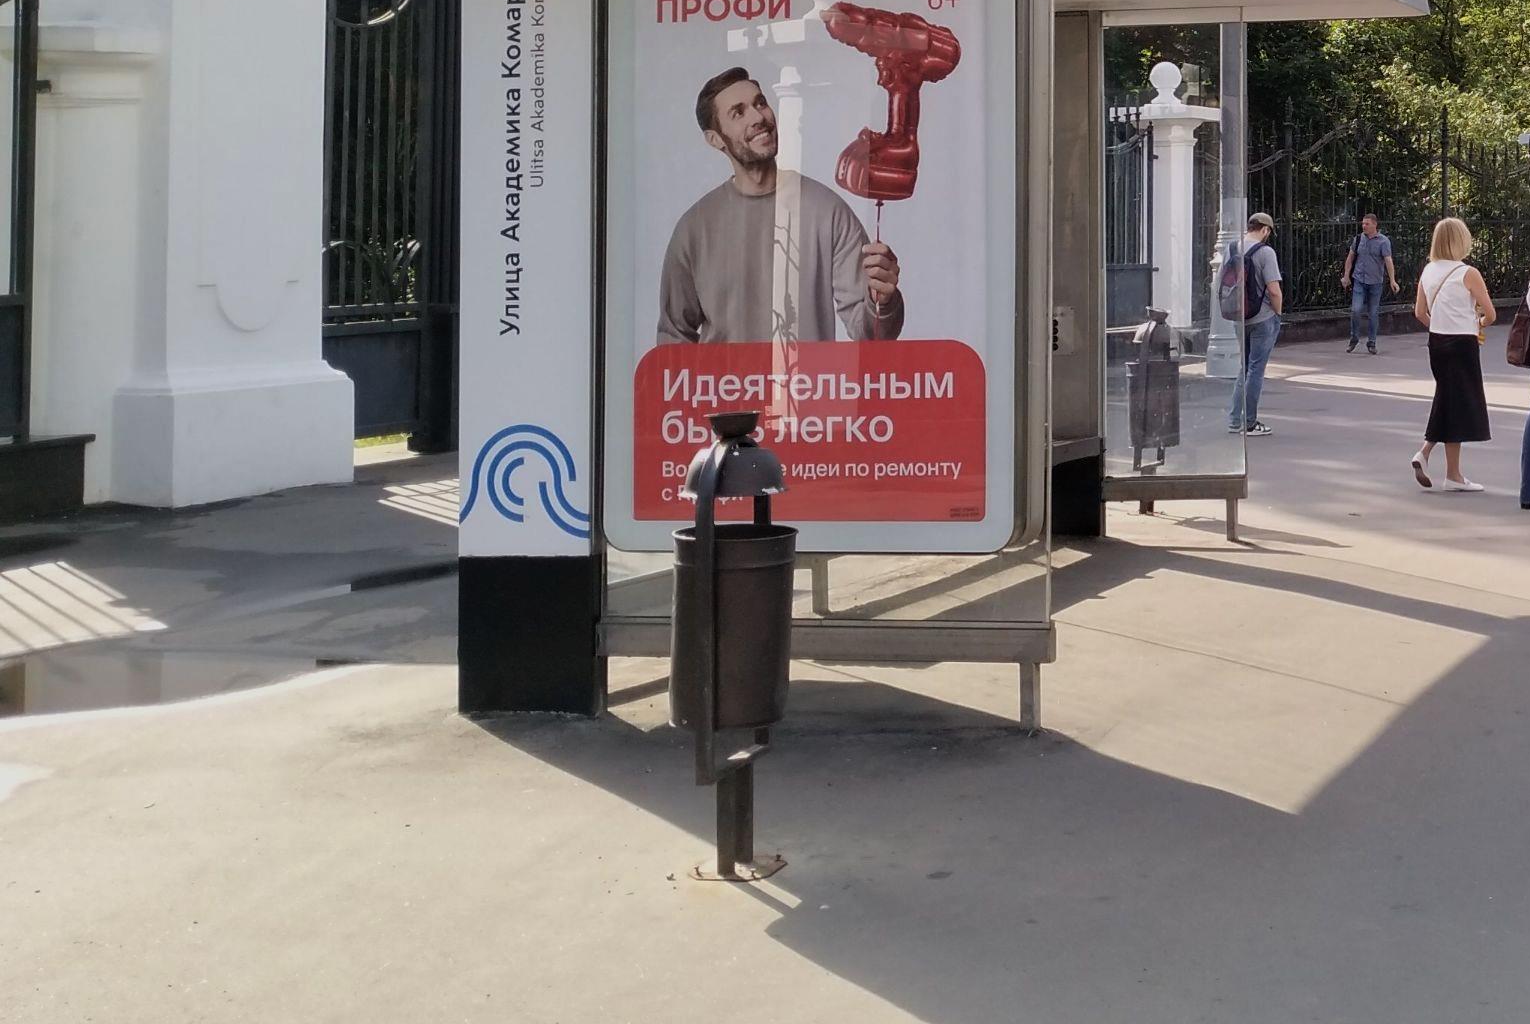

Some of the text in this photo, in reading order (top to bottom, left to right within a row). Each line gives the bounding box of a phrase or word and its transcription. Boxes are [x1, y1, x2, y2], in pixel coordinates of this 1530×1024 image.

[530, 33, 545, 132] Akademika
[500, 88, 524, 241] Академика
[530, 139, 545, 188] Ulitsa
[499, 252, 523, 334] Улица
[663, 368, 954, 406] Идеятельным
[774, 415, 893, 443] легко
[792, 463, 840, 479] идеи
[845, 462, 869, 477] по
[873, 461, 962, 480] ремонту
[661, 487, 673, 501] с
